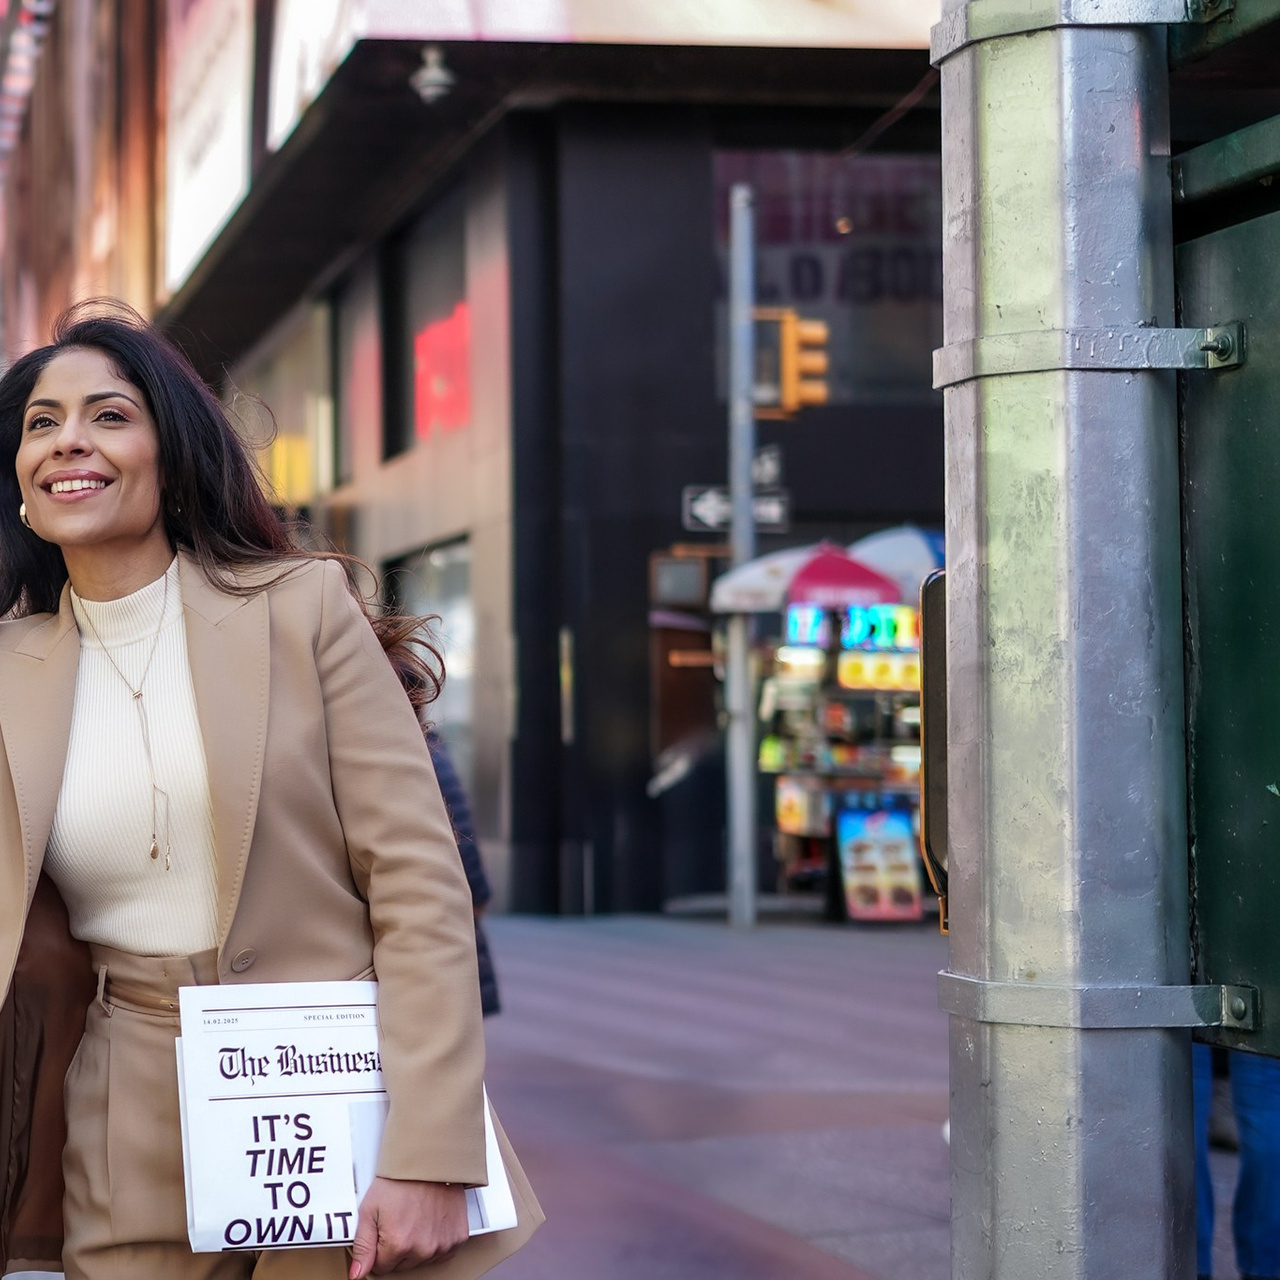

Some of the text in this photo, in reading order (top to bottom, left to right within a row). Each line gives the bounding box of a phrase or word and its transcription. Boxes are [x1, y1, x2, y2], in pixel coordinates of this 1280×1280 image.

[218, 1046, 270, 1086] The
[252, 1113, 313, 1143] IT’S
[245, 1146, 326, 1177] TIME
[263, 1181, 311, 1210] TO
[224, 1211, 353, 1246] OWN IT
